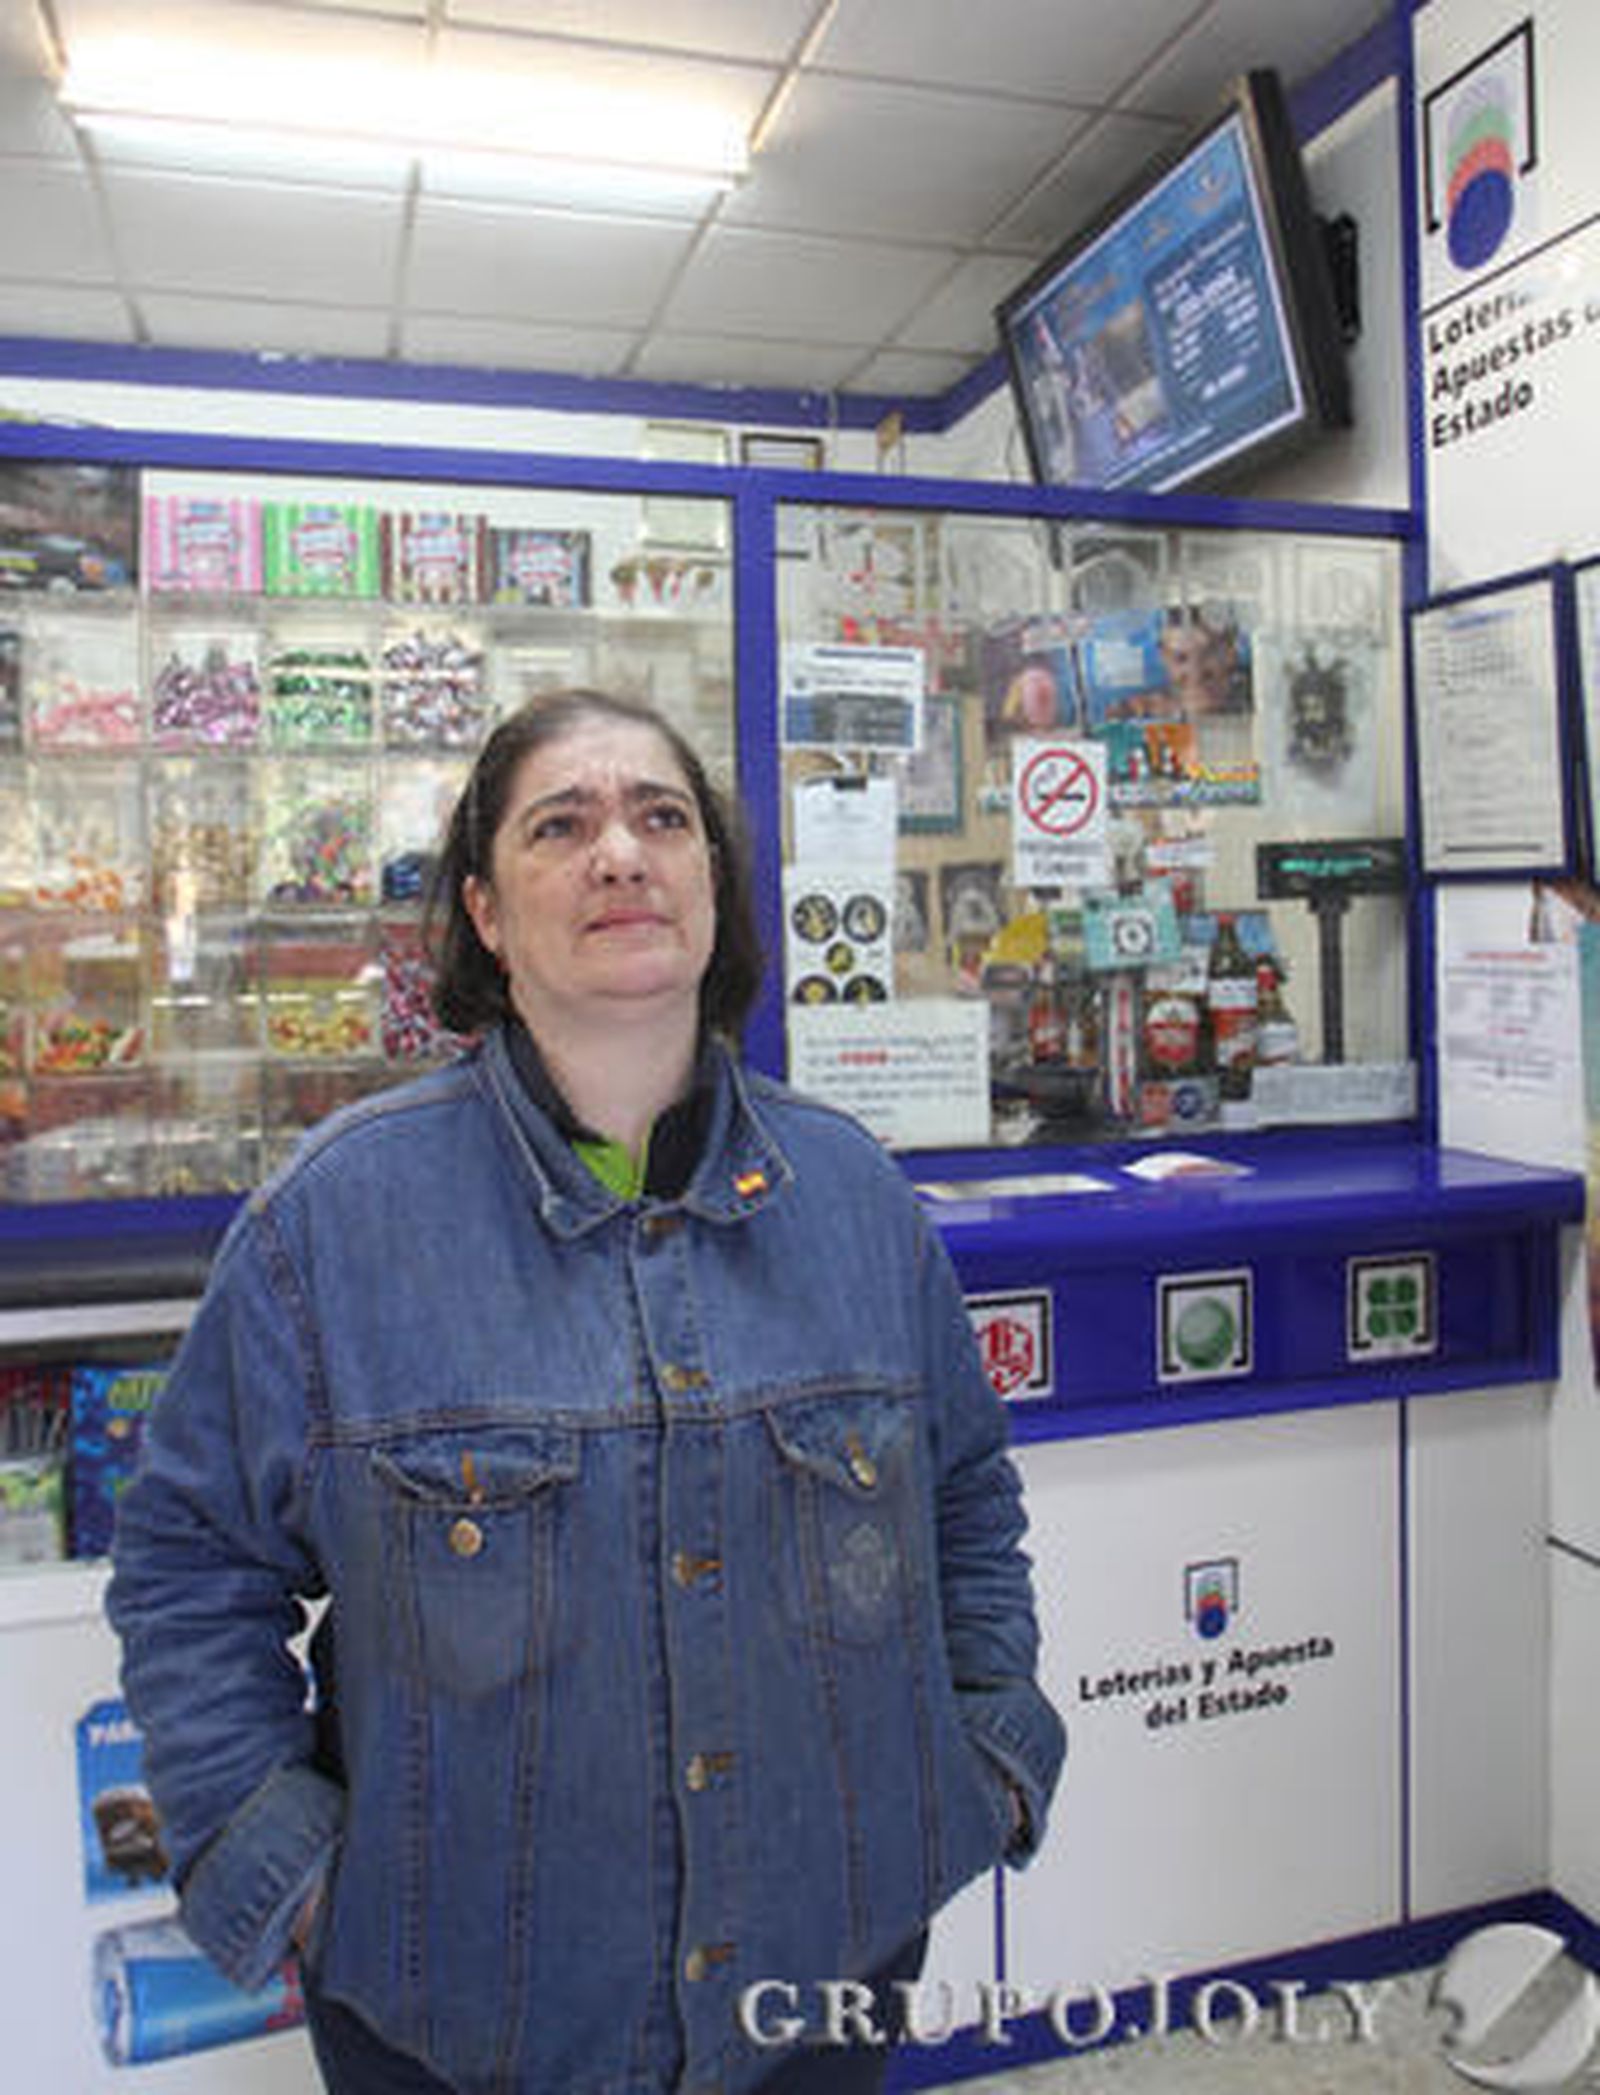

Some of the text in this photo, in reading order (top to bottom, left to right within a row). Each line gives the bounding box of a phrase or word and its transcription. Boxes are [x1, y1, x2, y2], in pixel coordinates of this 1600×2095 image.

[1432, 308, 1573, 401] Apuestas
[1432, 380, 1534, 448] Estado
[1201, 1660, 1216, 1686] y
[1145, 1682, 1289, 1730] del Estado
